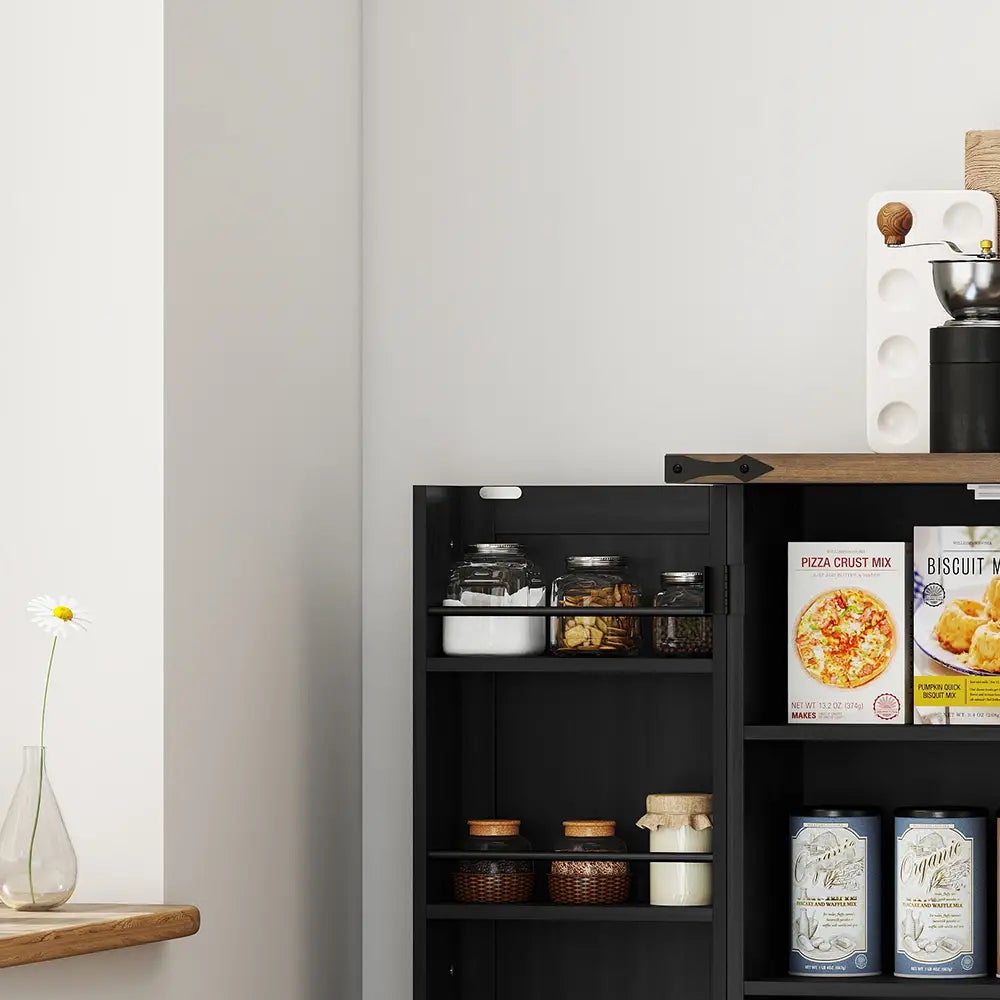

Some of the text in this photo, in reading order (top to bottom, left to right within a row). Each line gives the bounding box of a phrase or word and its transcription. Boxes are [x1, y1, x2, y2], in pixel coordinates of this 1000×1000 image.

[801, 557, 891, 567] PIZZA CRUST MIX
[928, 558, 984, 575] BISCUIT
[901, 840, 961, 884] Organic
